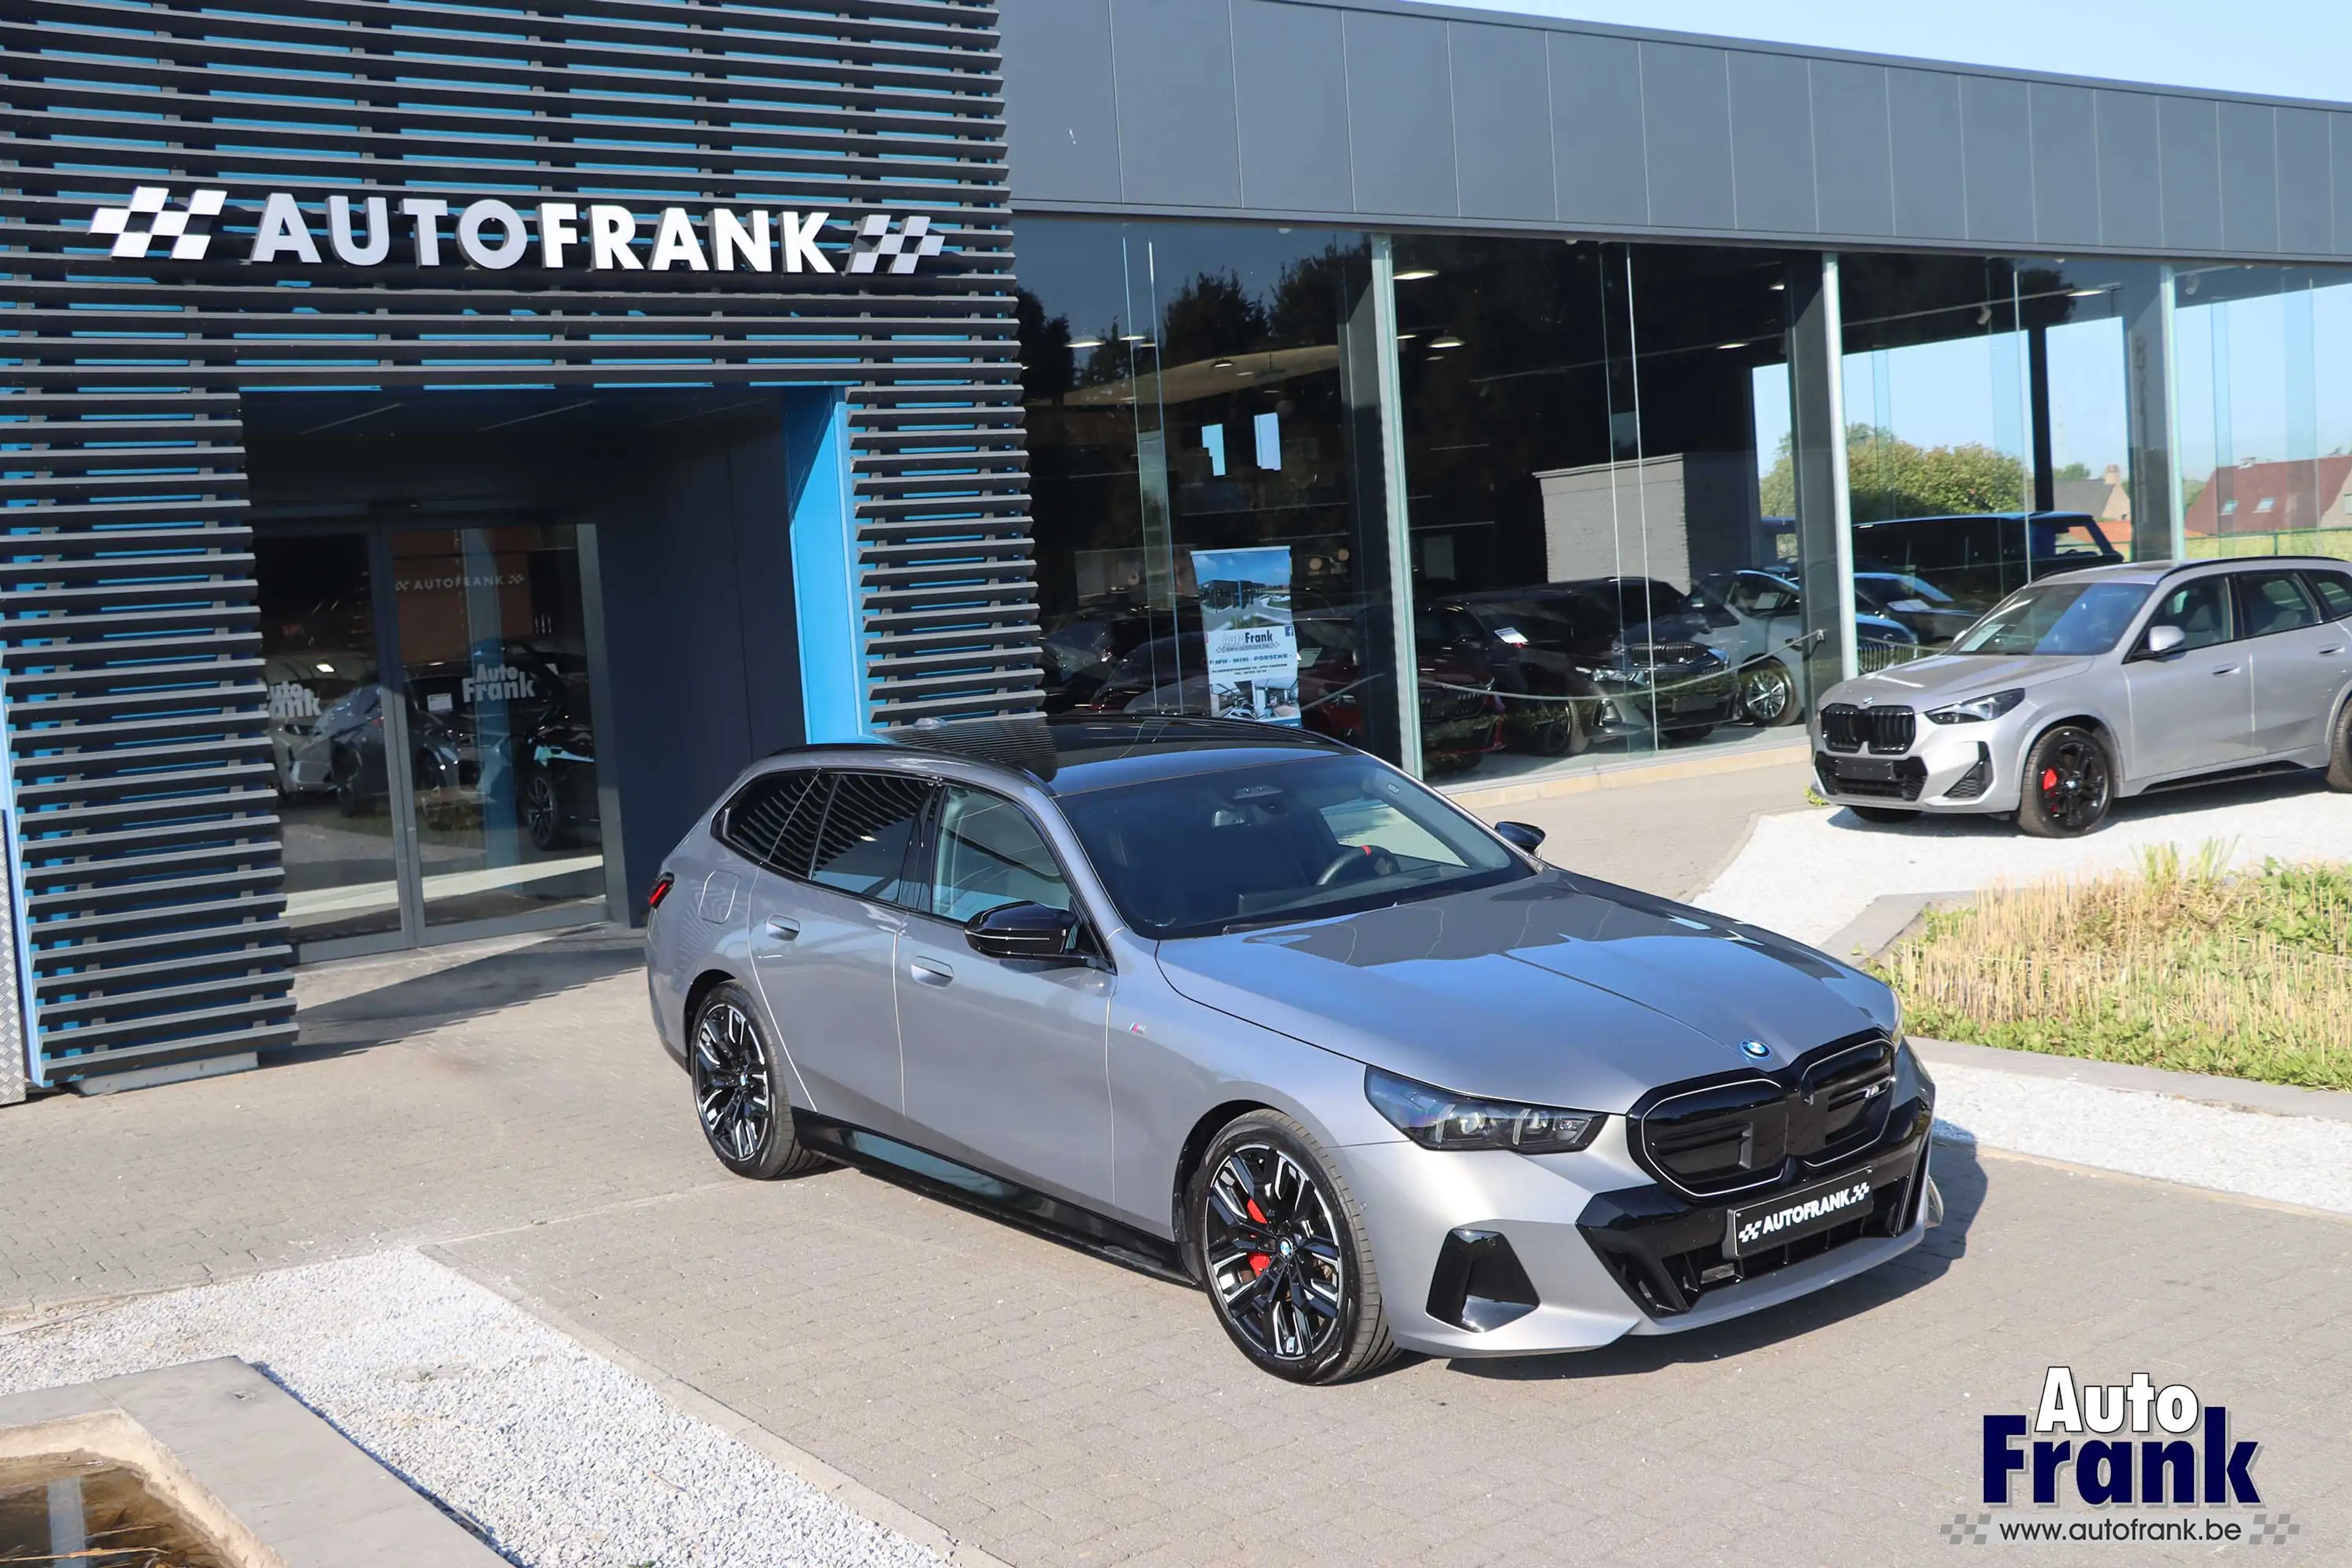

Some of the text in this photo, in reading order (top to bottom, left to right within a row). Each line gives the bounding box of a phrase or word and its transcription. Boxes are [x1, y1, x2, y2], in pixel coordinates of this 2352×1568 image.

[248, 192, 837, 274] AUTOFRANK
[413, 575, 504, 590] AUTOFRANK
[1245, 630, 1273, 643] Frank
[475, 663, 518, 682] Auto
[268, 680, 303, 698] uto
[462, 671, 536, 703] Frank
[258, 688, 322, 720] ank
[1763, 1188, 1851, 1234] AUTOFRANK
